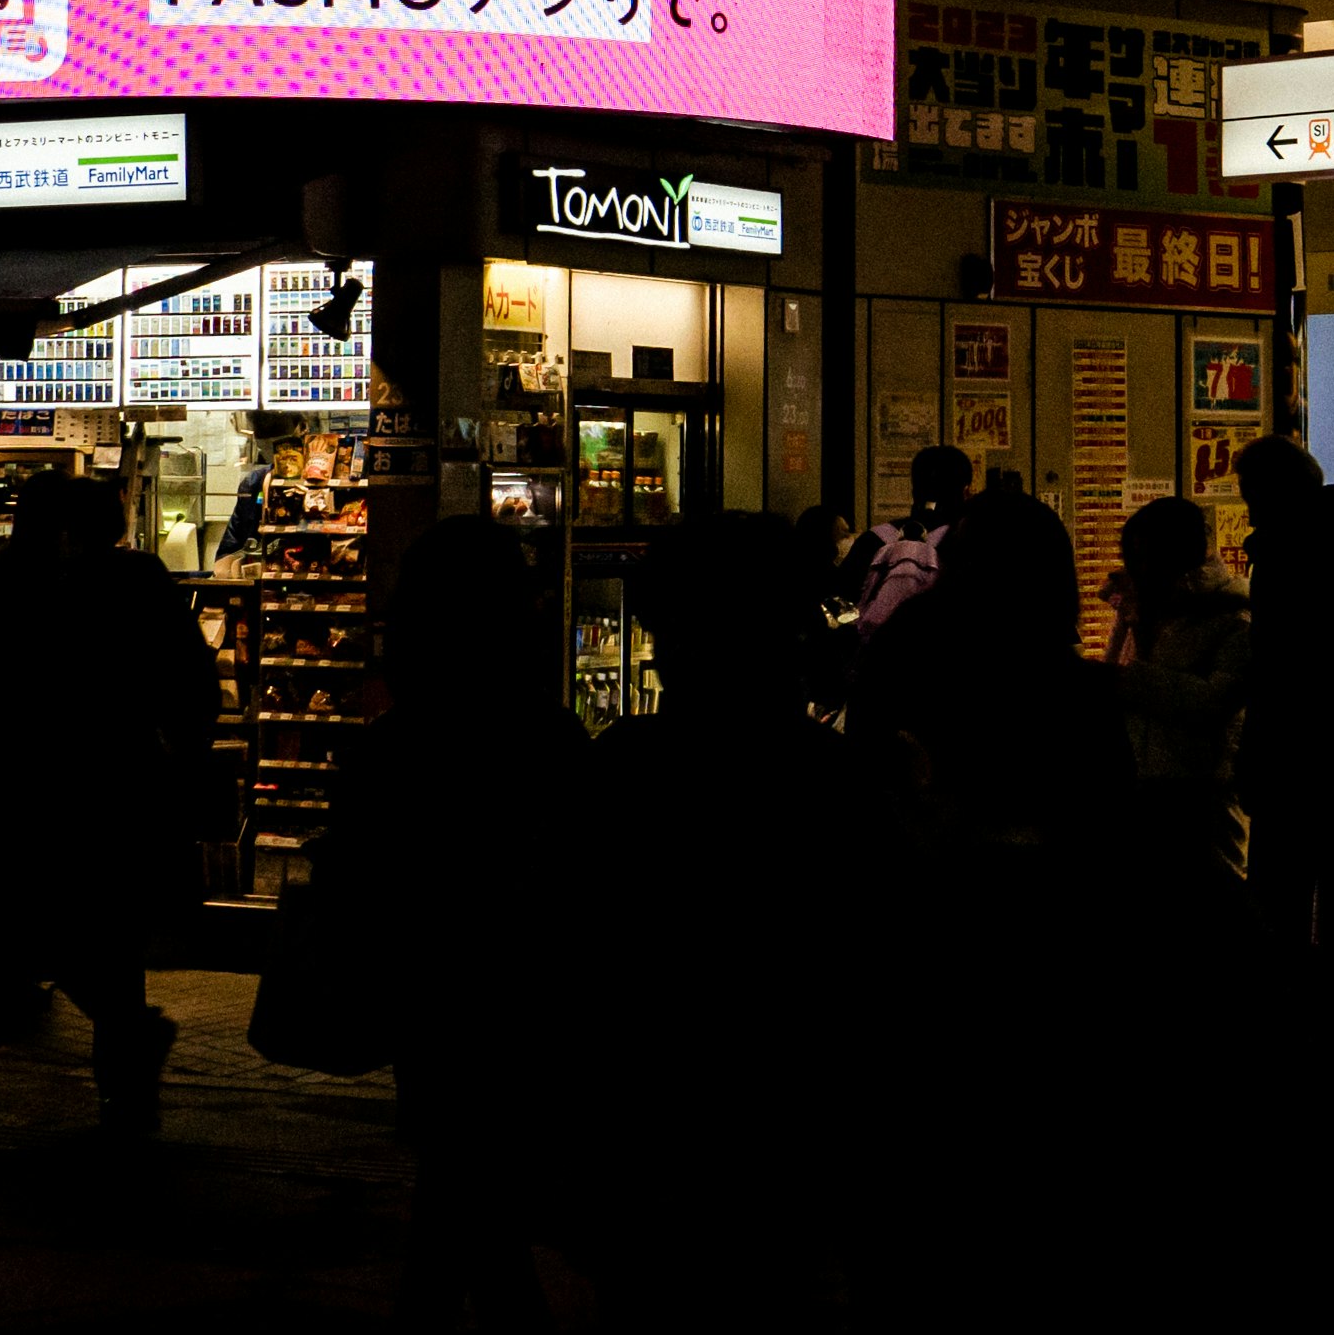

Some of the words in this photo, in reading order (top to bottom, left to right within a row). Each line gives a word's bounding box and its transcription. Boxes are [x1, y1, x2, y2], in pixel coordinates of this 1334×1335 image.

[908, 1, 1038, 53] 2023
[1153, 54, 1219, 120] 連
[908, 103, 1038, 154] 出てます
[1313, 123, 1326, 138] SI
[88, 165, 170, 184] FamilyMart
[533, 168, 684, 244] TOMONI
[1005, 208, 1100, 248] ジャンボ
[741, 223, 774, 237] FamilyMart
[1017, 251, 1086, 291] 宝くじ
[1112, 224, 1262, 291] 最終日!
